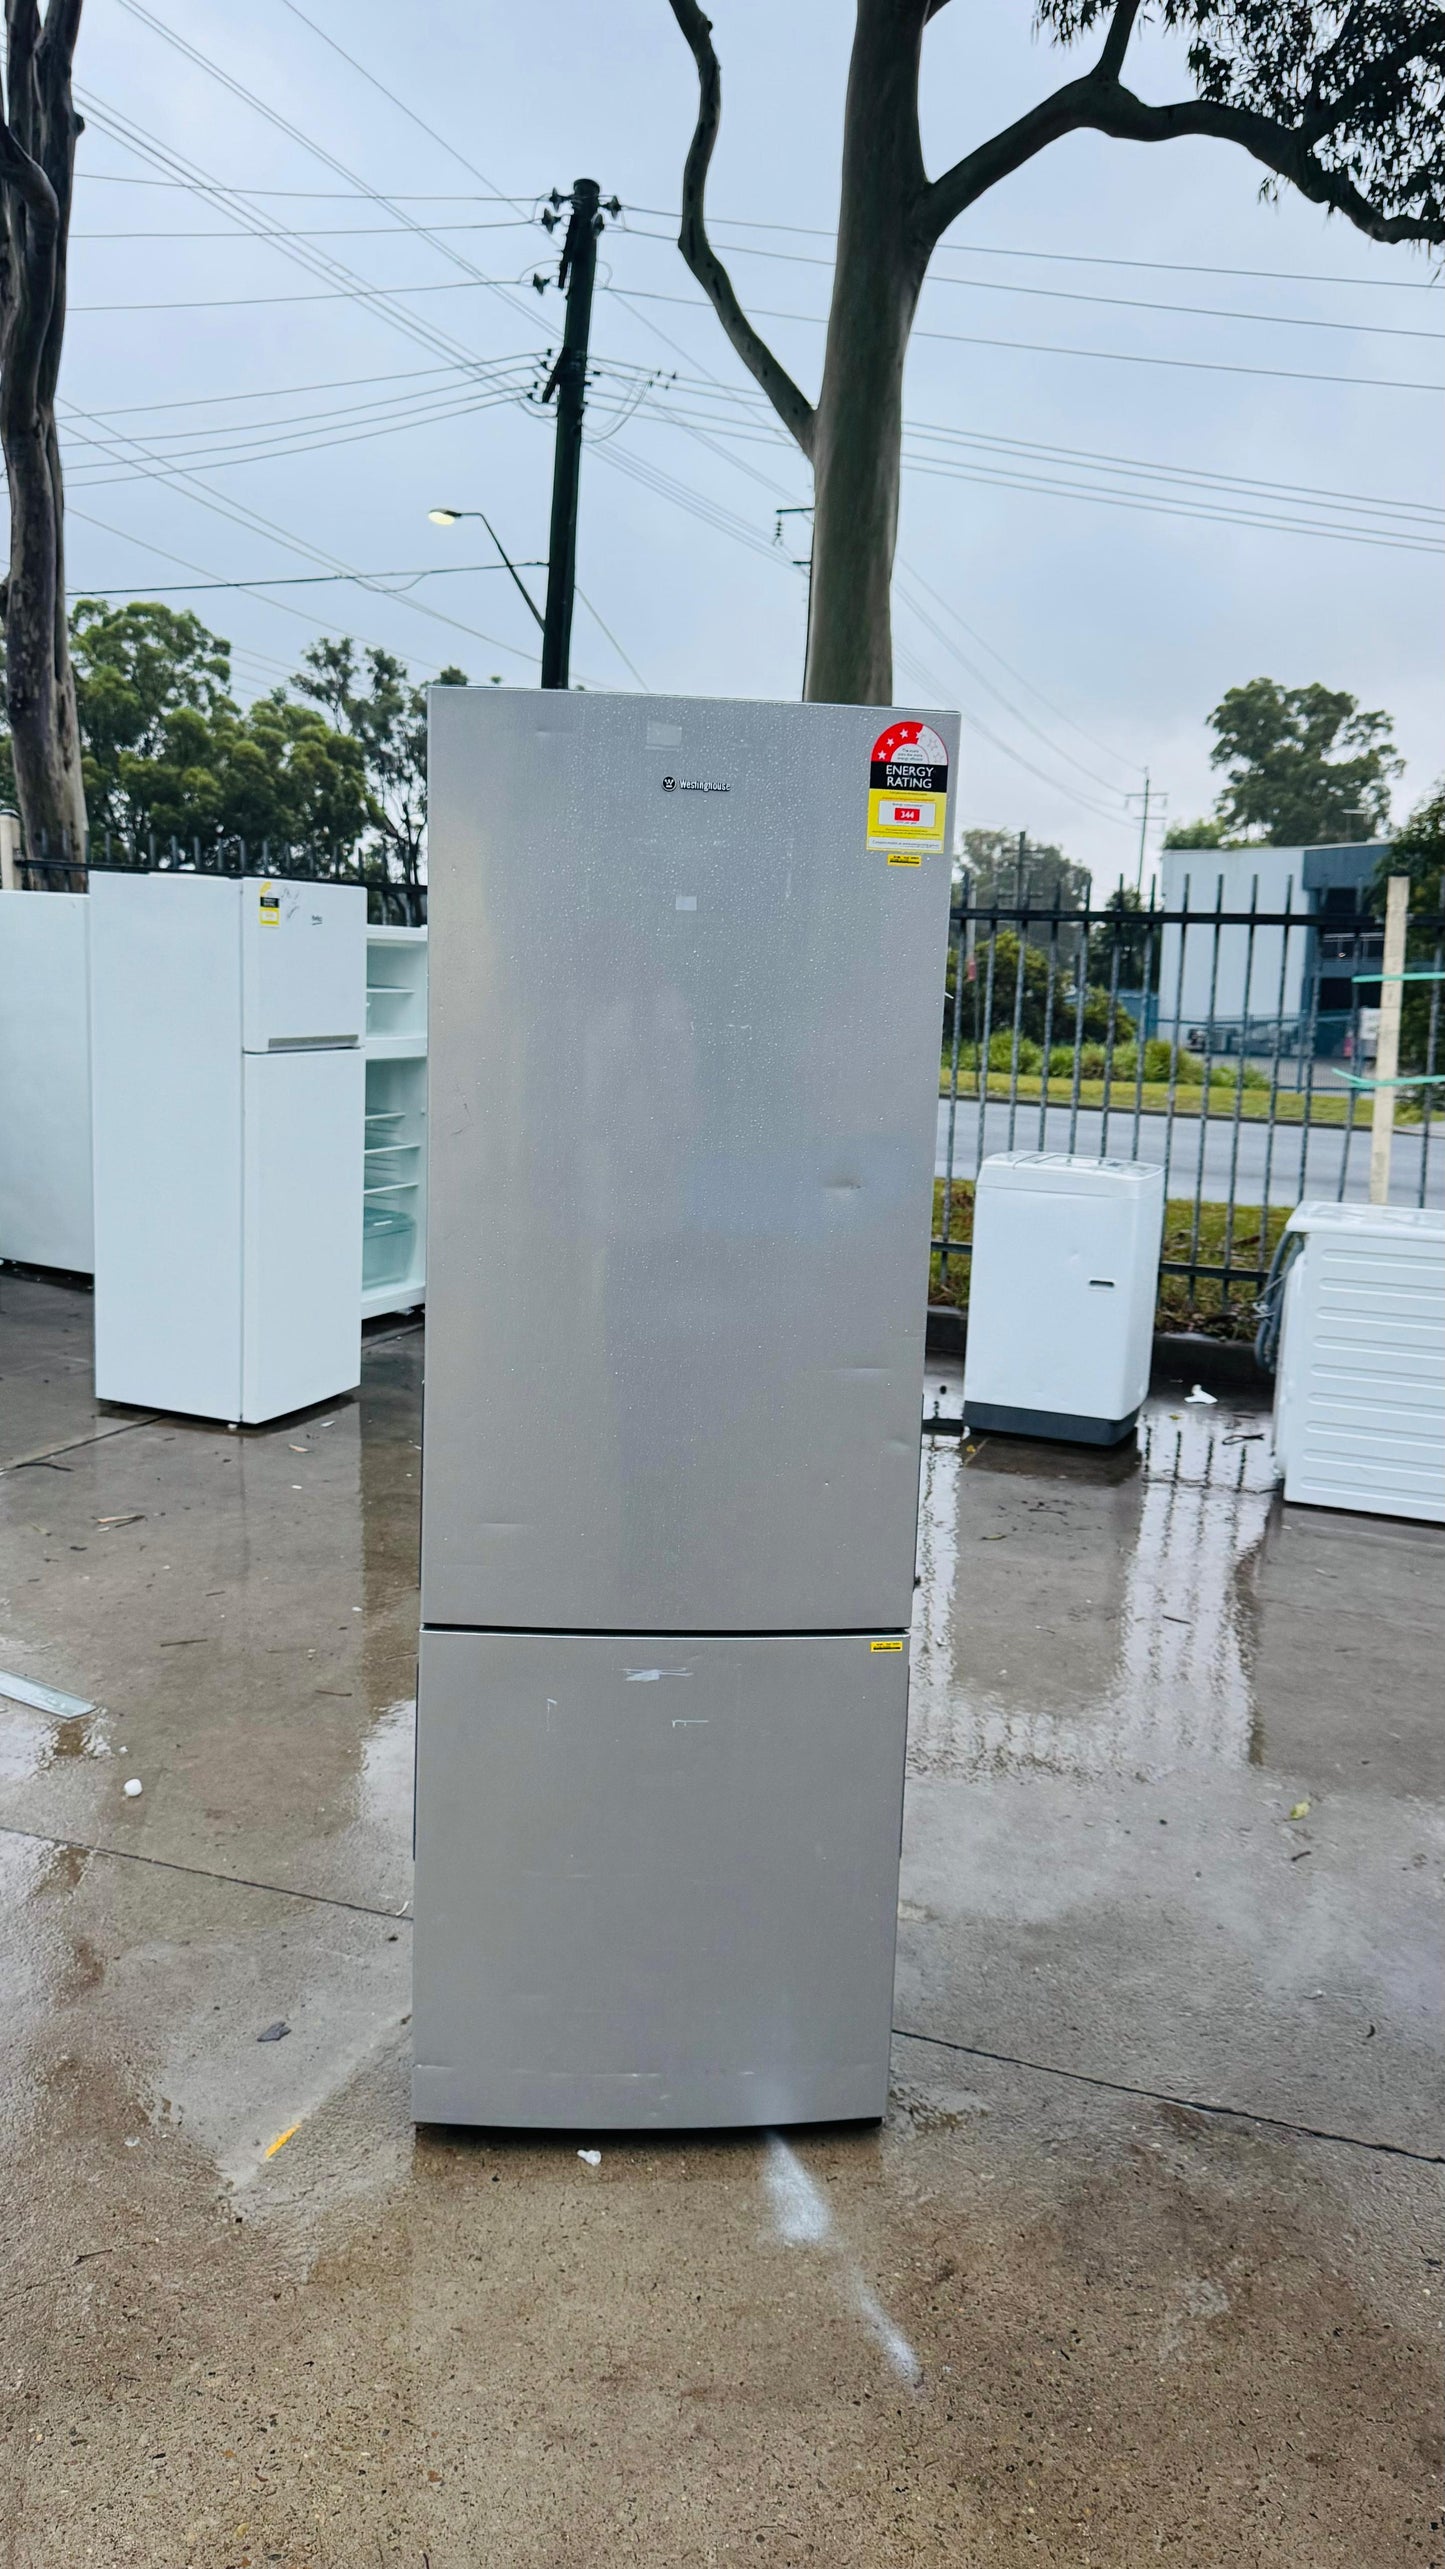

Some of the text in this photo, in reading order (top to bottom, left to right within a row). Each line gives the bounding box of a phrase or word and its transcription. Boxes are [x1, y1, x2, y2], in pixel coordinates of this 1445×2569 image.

[886, 764, 934, 777] ENERGY
[679, 779, 731, 792] Westinghouse
[886, 777, 932, 789] RATING
[900, 810, 915, 819] 344
